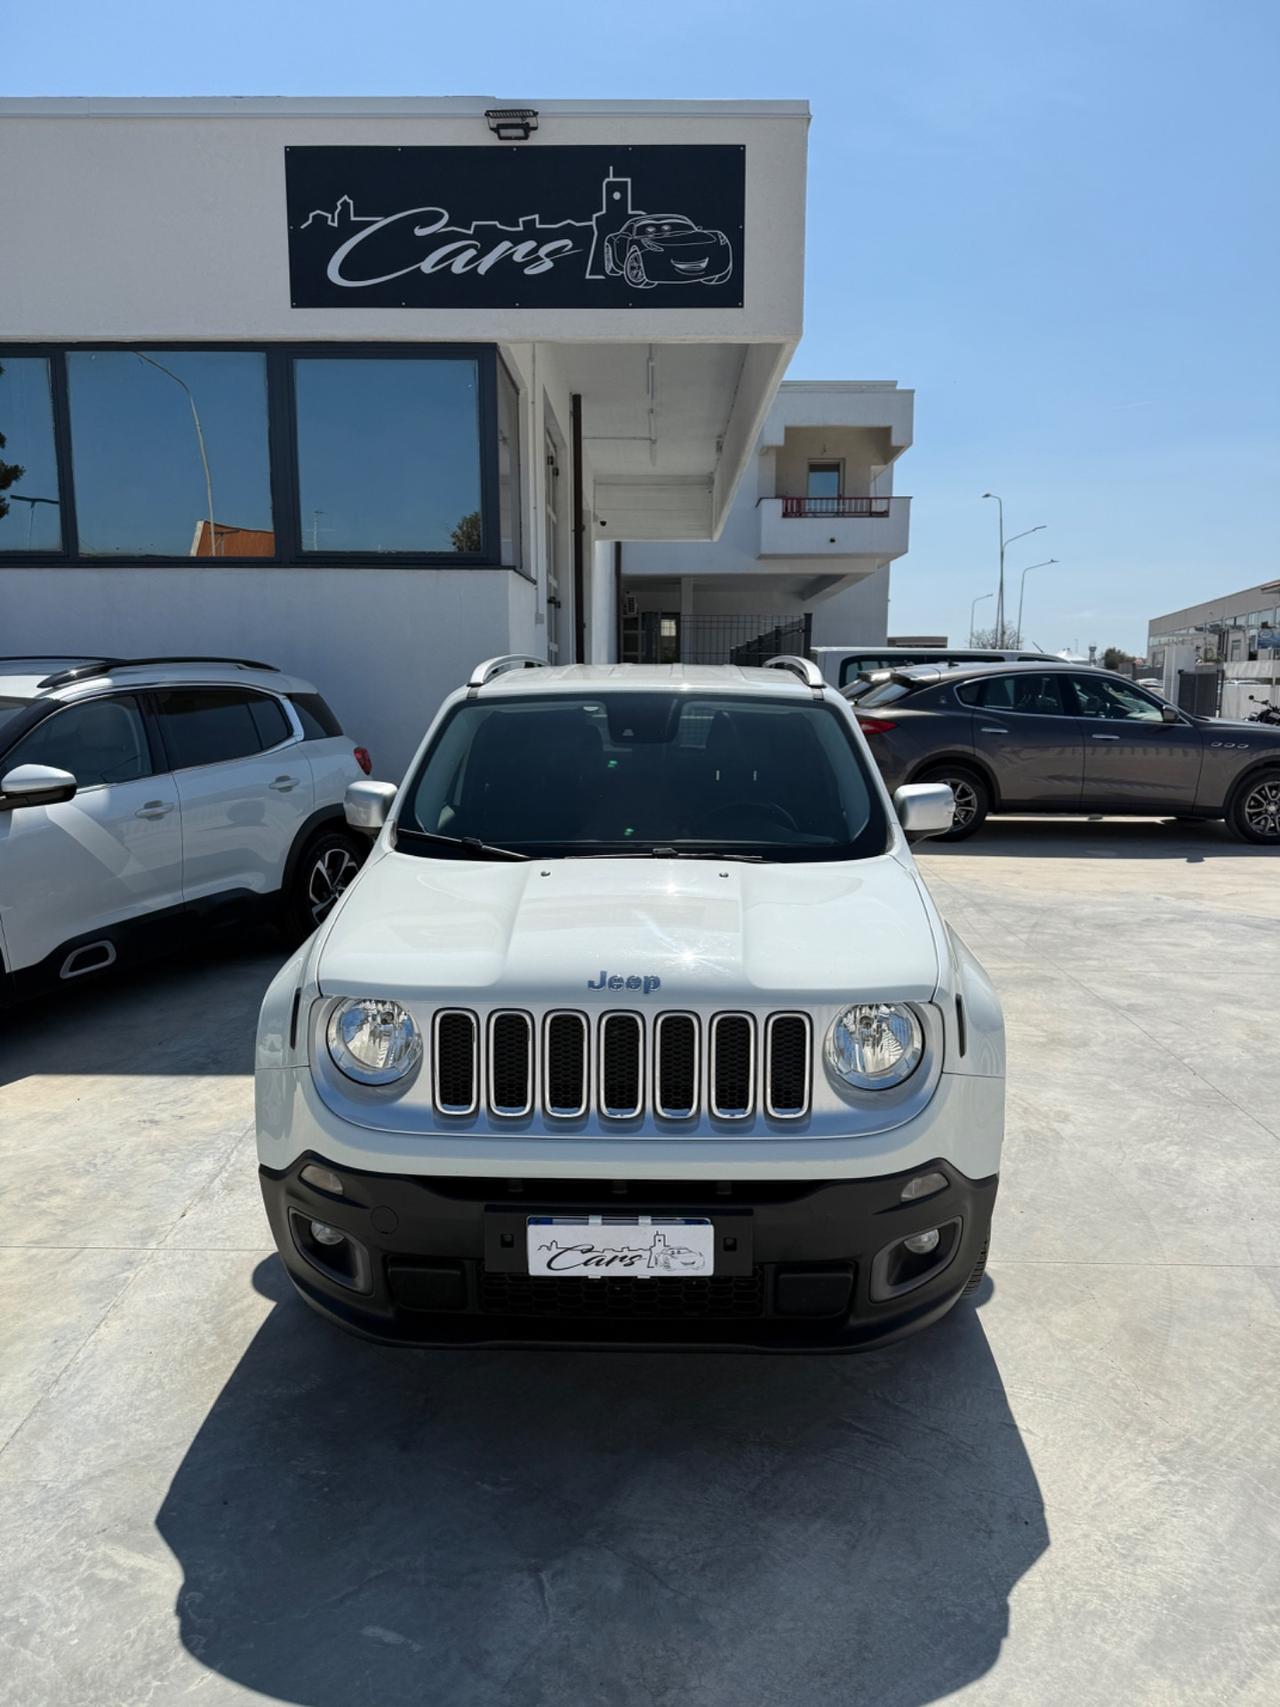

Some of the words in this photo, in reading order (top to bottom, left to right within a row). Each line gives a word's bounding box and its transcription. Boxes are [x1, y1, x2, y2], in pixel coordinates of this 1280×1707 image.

[327, 206, 583, 287] Cars
[588, 970, 661, 994] Jeep
[547, 1244, 645, 1271] Cars
